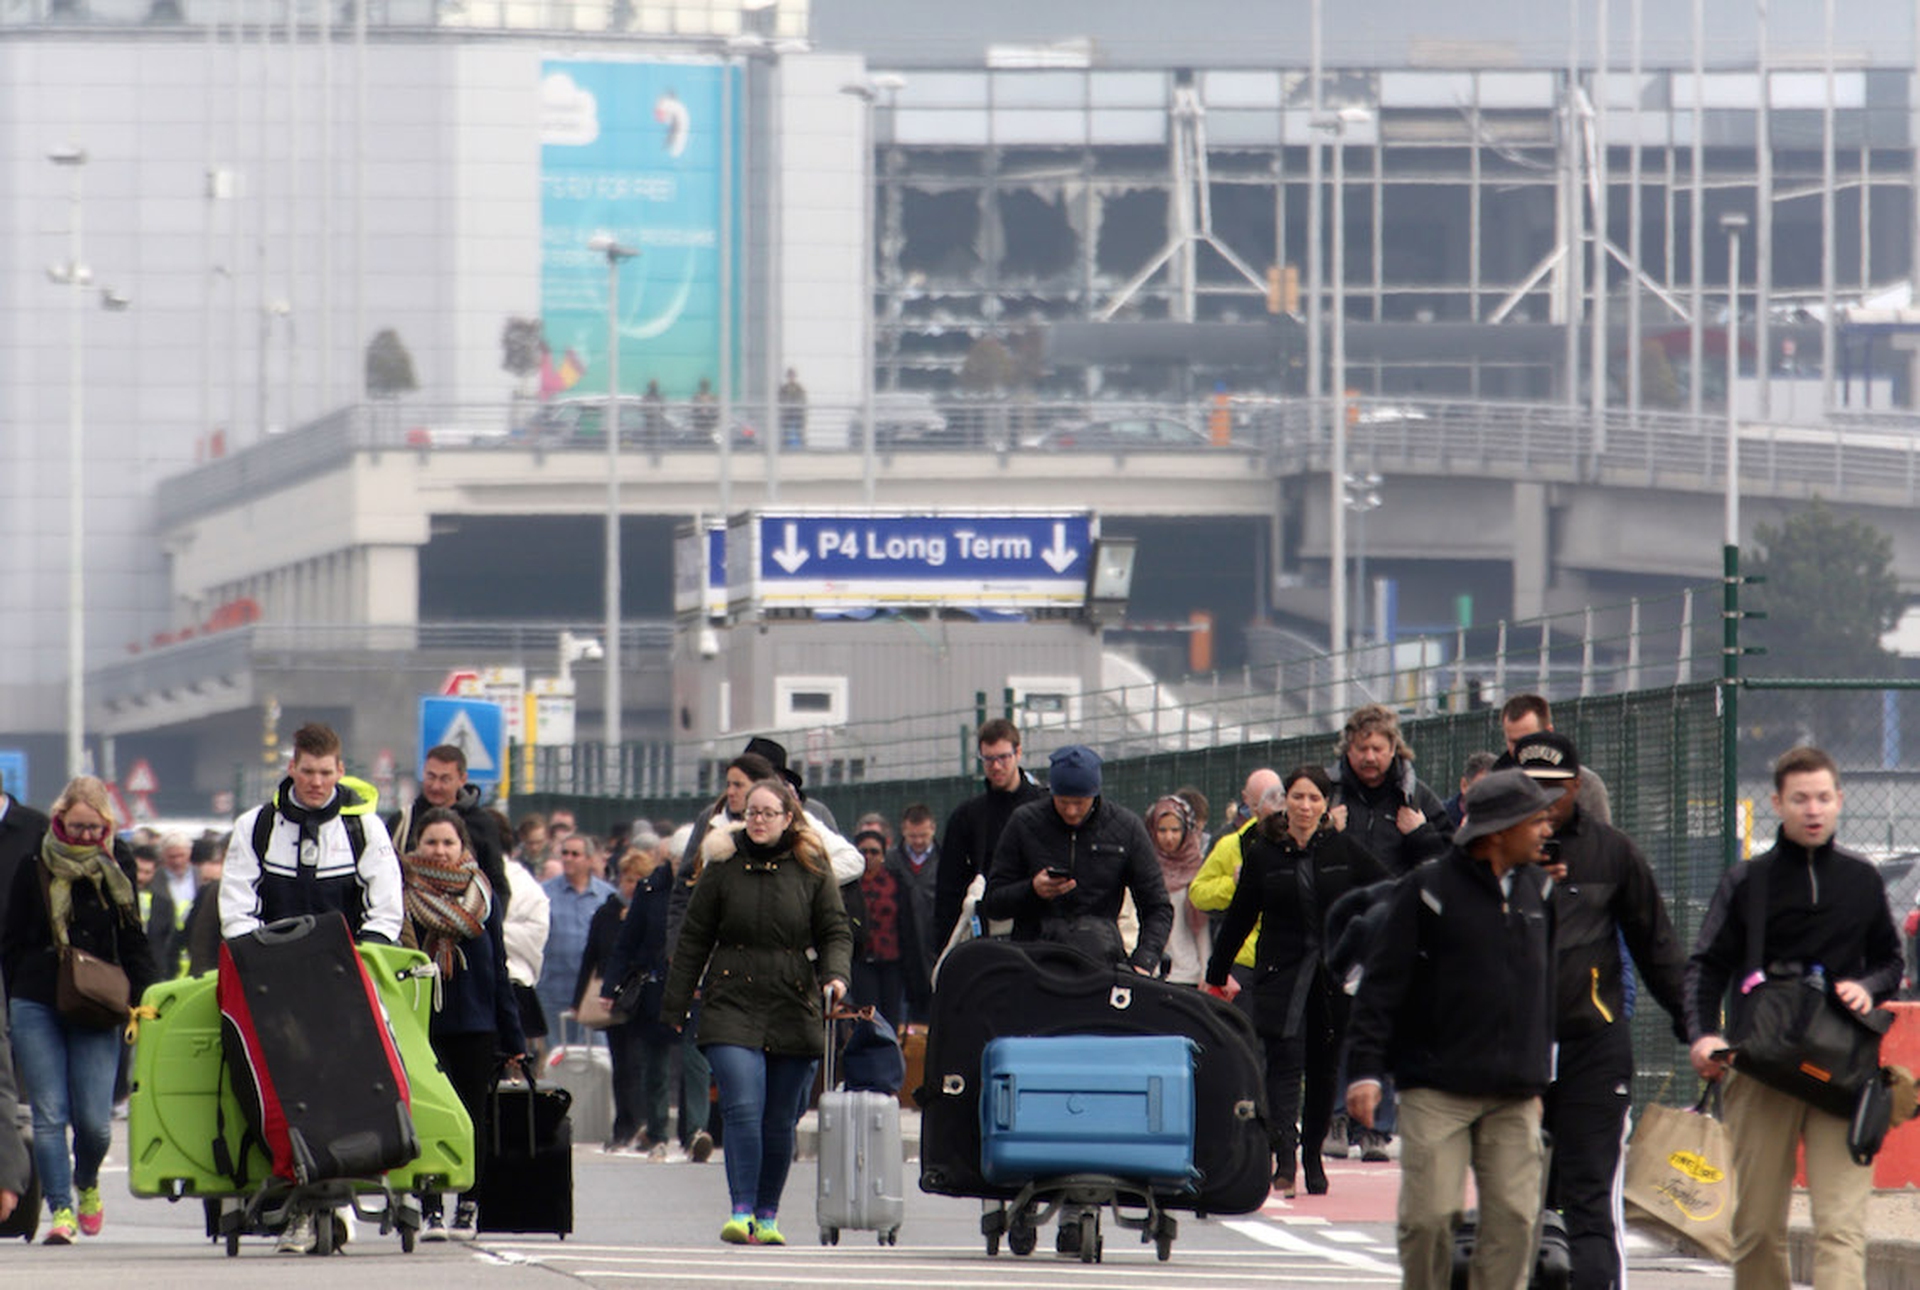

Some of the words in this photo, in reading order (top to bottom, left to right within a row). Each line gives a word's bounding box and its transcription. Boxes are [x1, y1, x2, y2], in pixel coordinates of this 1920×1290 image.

[817, 531, 860, 560] P4
[866, 531, 948, 566] Long
[953, 530, 1033, 560] Term
